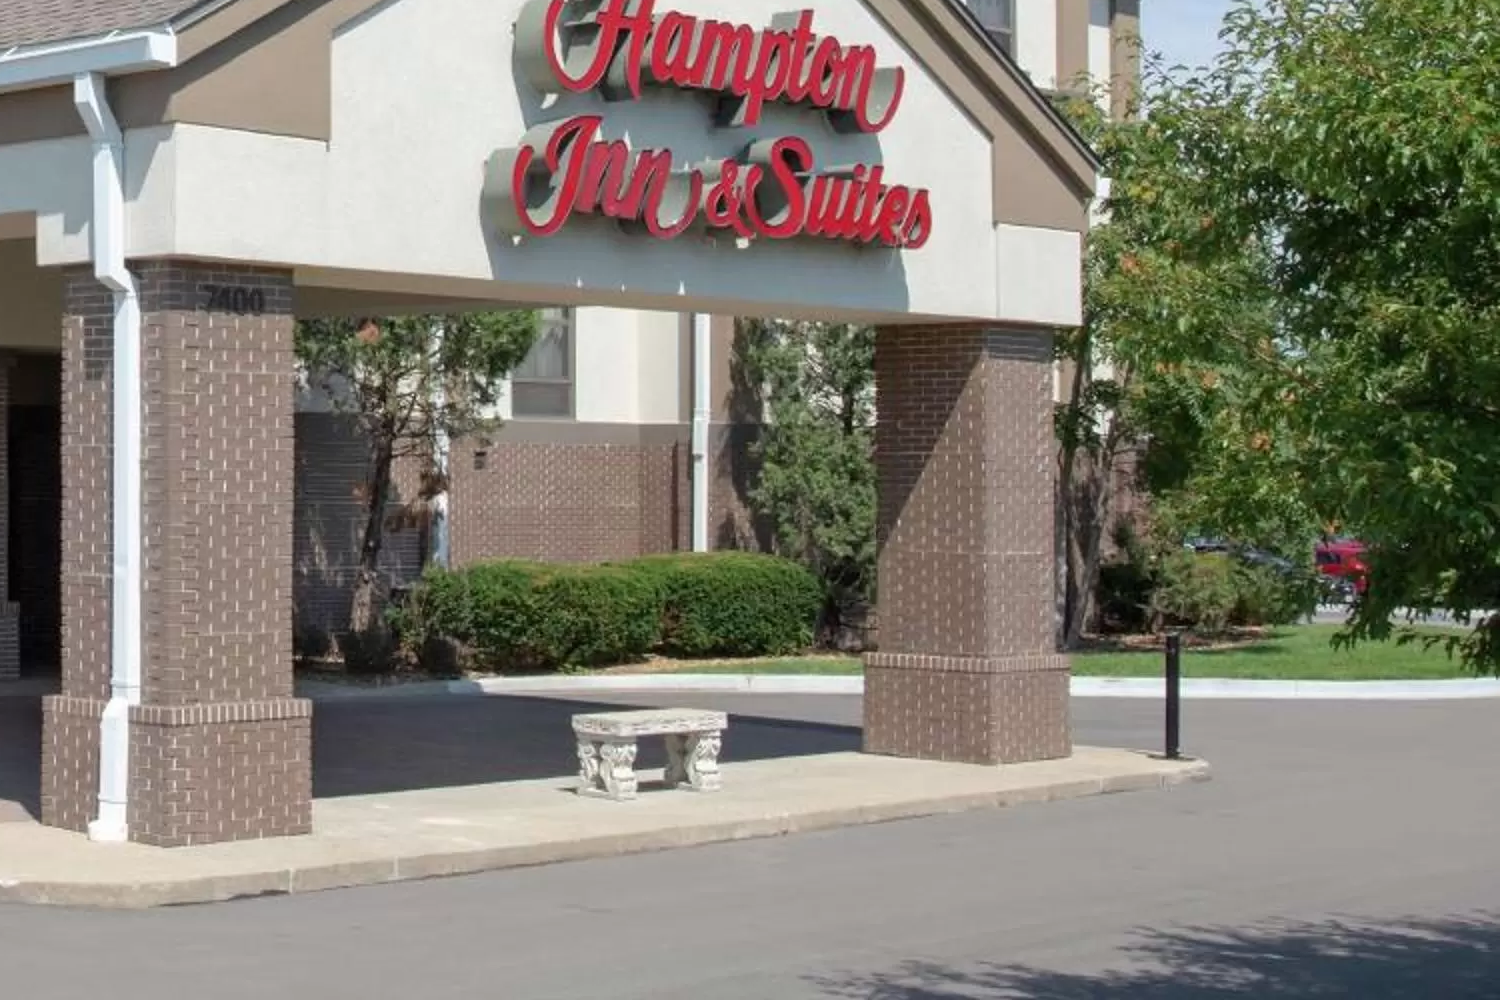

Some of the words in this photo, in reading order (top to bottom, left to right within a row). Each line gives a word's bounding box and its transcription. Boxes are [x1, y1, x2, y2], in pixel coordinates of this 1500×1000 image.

[512, 115, 702, 238] Inn
[705, 159, 756, 238] &
[746, 136, 932, 249] Suites
